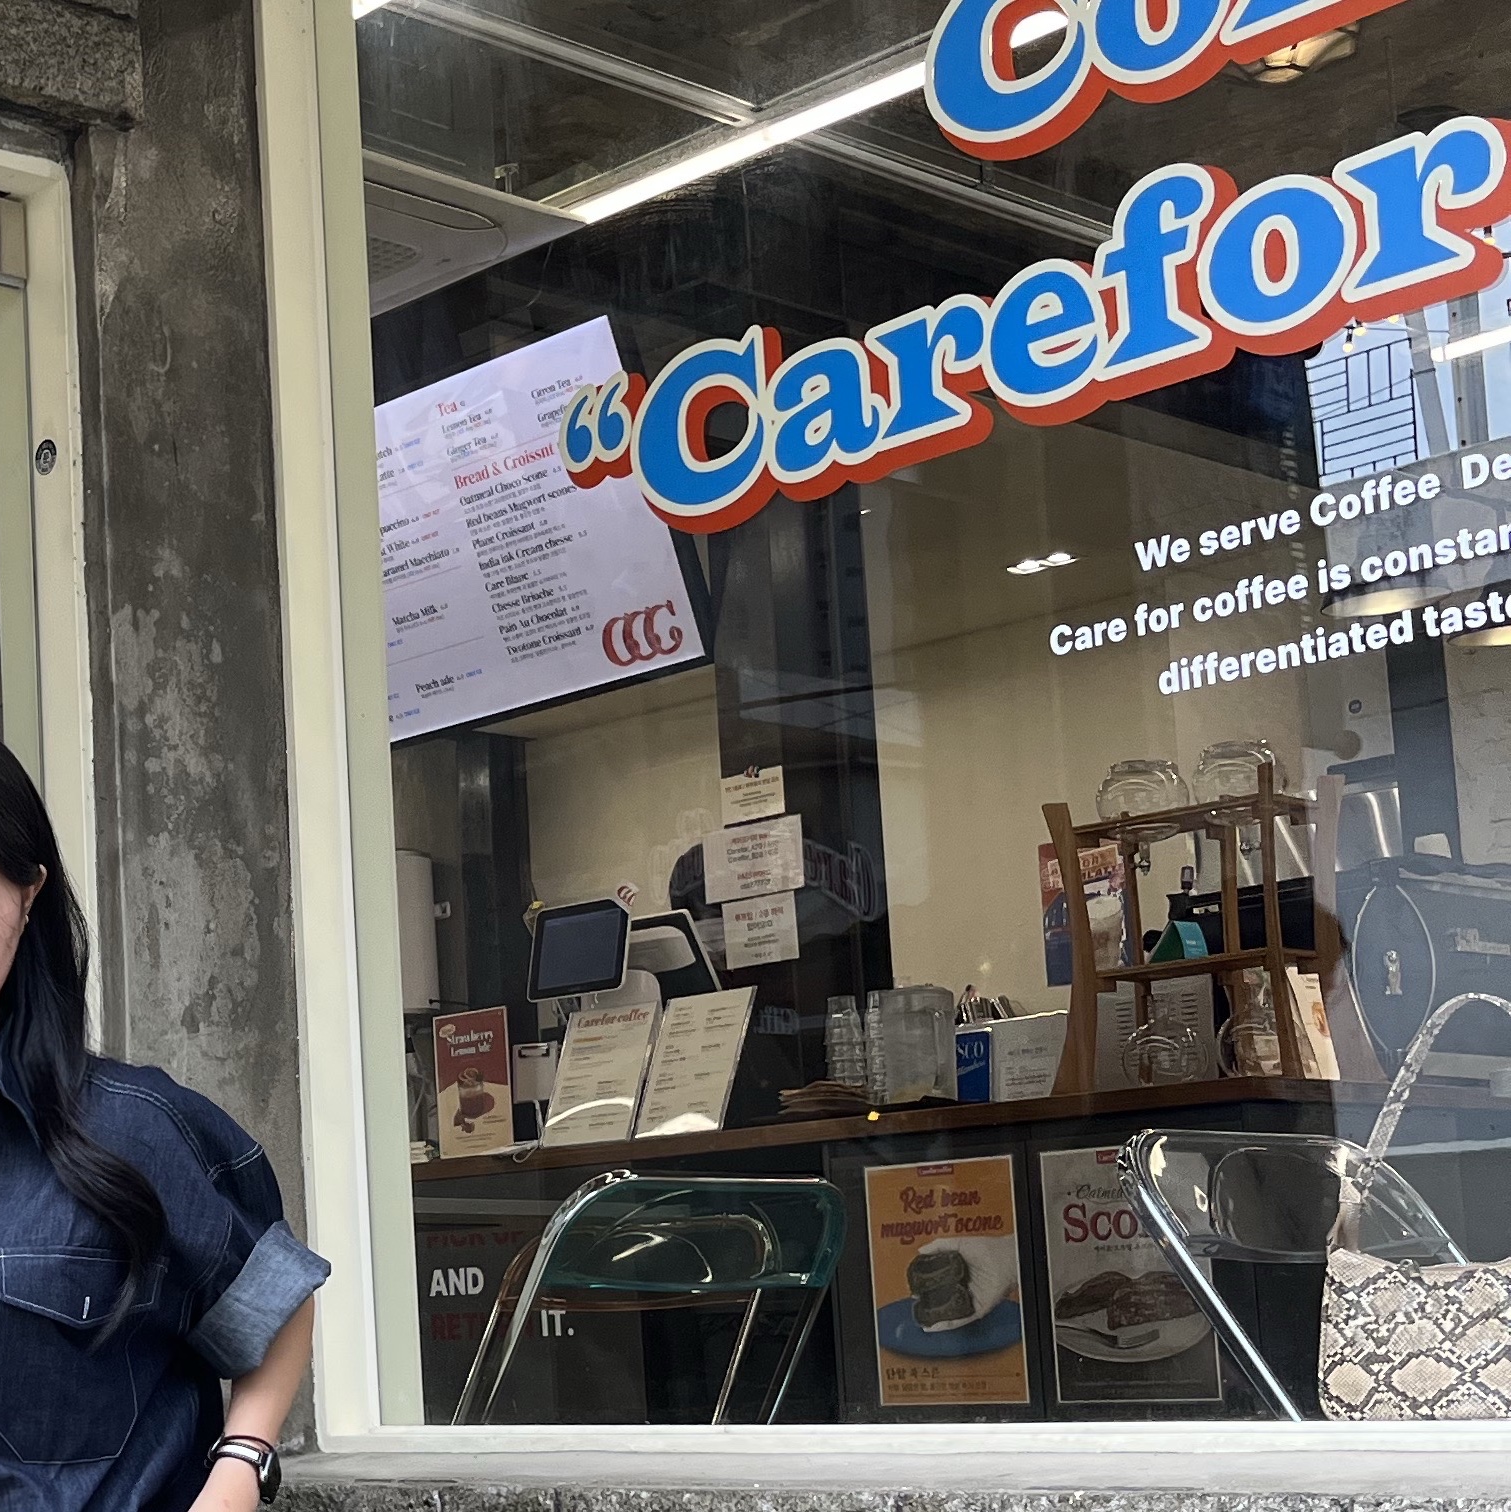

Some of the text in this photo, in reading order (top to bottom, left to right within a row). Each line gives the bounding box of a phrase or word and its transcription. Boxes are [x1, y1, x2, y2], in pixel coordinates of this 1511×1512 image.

[556, 378, 572, 389] Tea
[437, 401, 458, 417] Tea
[468, 413, 482, 423] Tea
[453, 465, 490, 489] Bread
[492, 461, 502, 477] &
[494, 479, 522, 494] Choco
[521, 469, 548, 483] Scone
[465, 513, 482, 529] Red
[1134, 533, 1191, 573] We
[1198, 508, 1301, 557] serve
[1308, 468, 1441, 527] Coffee
[515, 543, 544, 559] Cream
[1048, 613, 1129, 656] Care
[1134, 600, 1186, 638] for
[1192, 570, 1310, 623] coffee
[1316, 558, 1353, 594] is
[1157, 613, 1414, 696] differentiated
[900, 1186, 982, 1214] Red bean
[880, 1213, 1004, 1245] mugwort scone
[429, 1266, 485, 1297] AND
[541, 1308, 575, 1337] IT.
